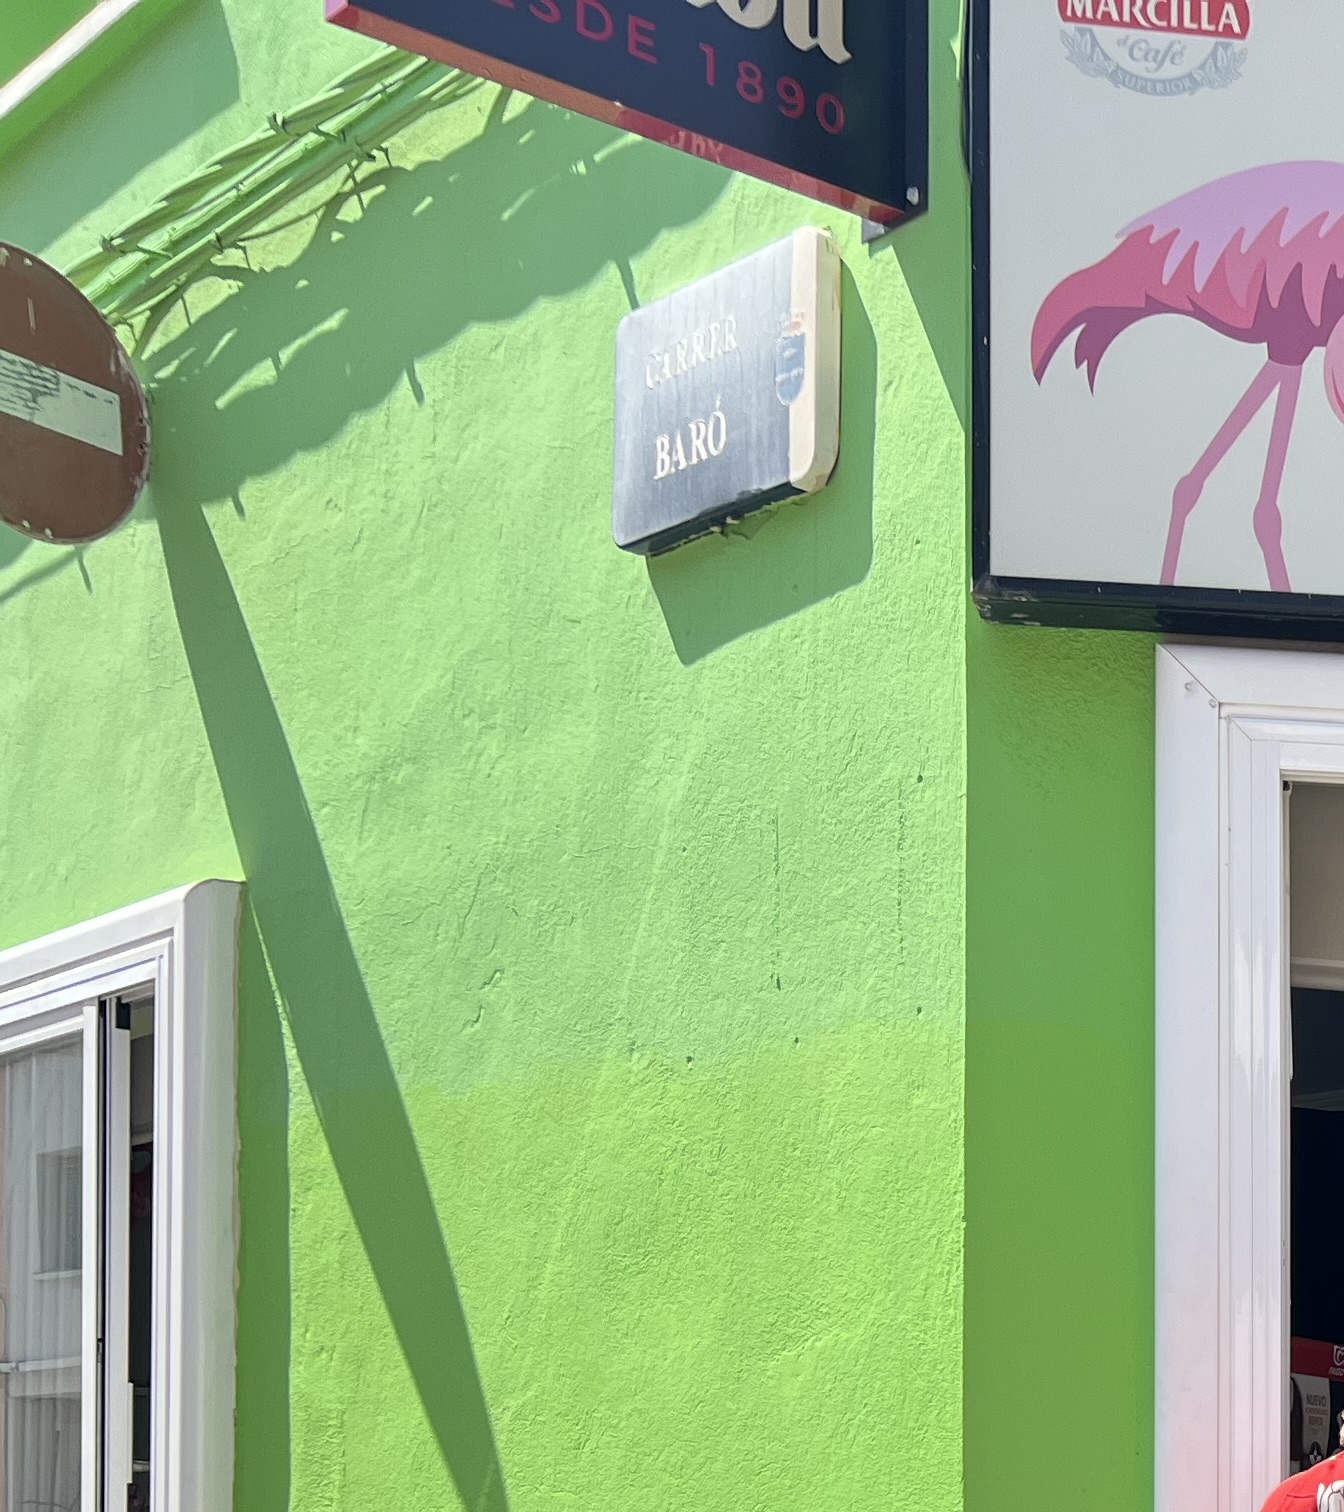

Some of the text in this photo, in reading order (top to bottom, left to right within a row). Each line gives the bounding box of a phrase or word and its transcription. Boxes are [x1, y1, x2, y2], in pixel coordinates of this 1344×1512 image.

[1066, 0, 1241, 34] MARCILLA
[1117, 71, 1194, 94] SUPERIOR
[1128, 38, 1188, 73] Café
[699, 42, 846, 135] 1890
[645, 316, 738, 389] CARRER
[654, 394, 728, 480] BARÓ
